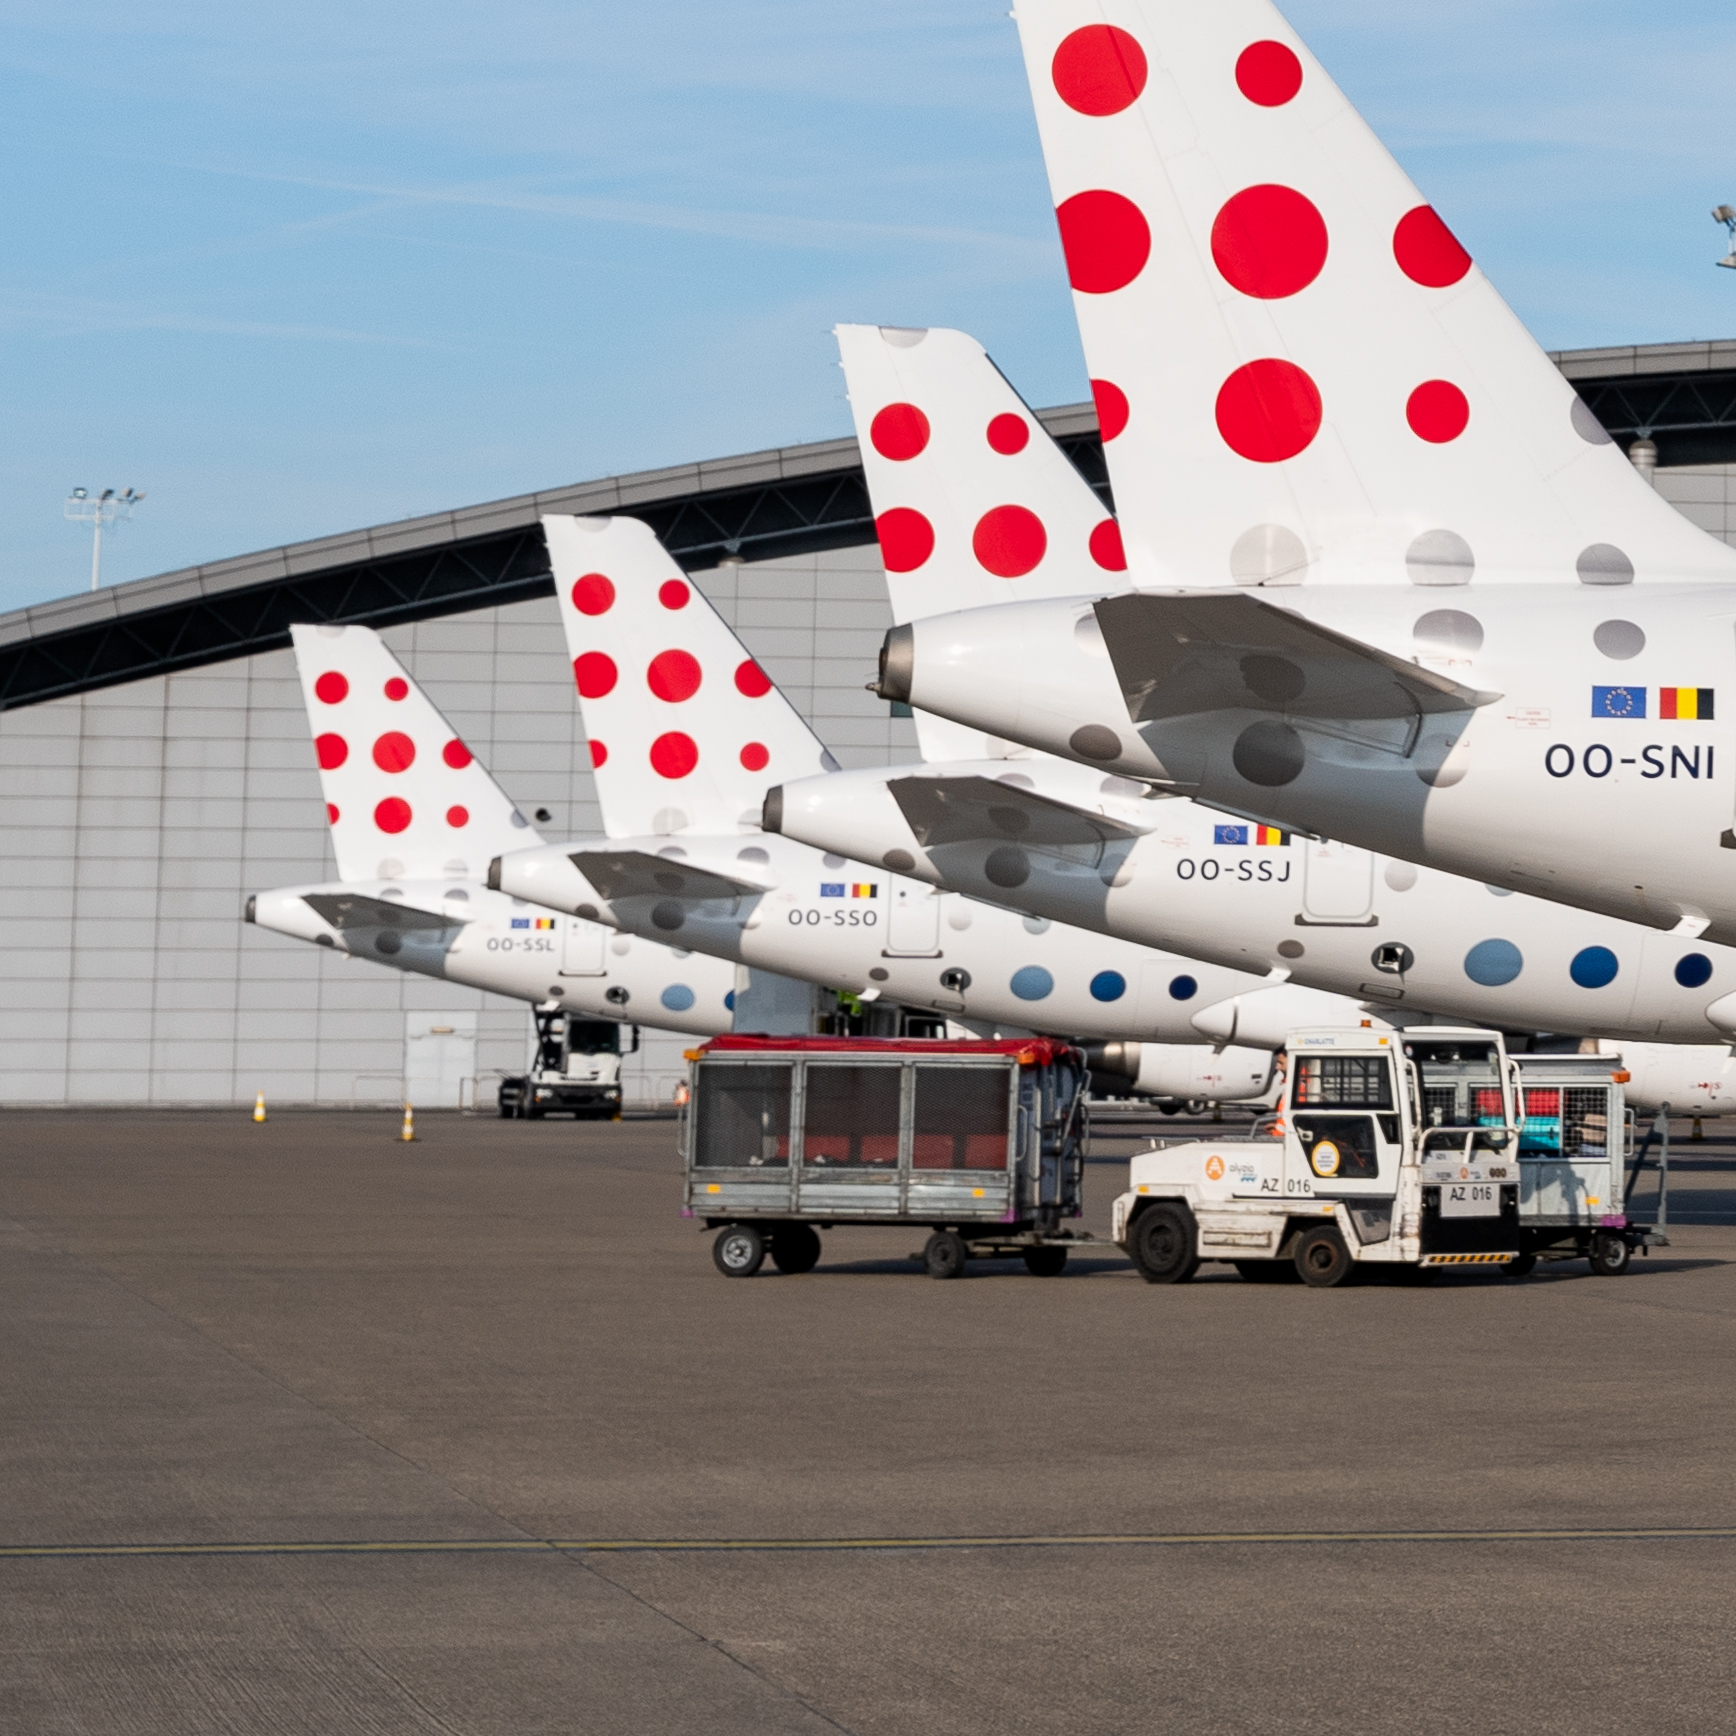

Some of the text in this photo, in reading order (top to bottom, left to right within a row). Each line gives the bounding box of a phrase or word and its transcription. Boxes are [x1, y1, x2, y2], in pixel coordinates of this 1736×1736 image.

[1545, 743, 1714, 779] OO-SNI
[1176, 858, 1290, 882] OO-SSJ
[788, 909, 877, 926] OO-SSO
[487, 937, 555, 952] OO-SSL
[1261, 1178, 1311, 1192] AZ 016
[1450, 1186, 1492, 1202] AZ 016
